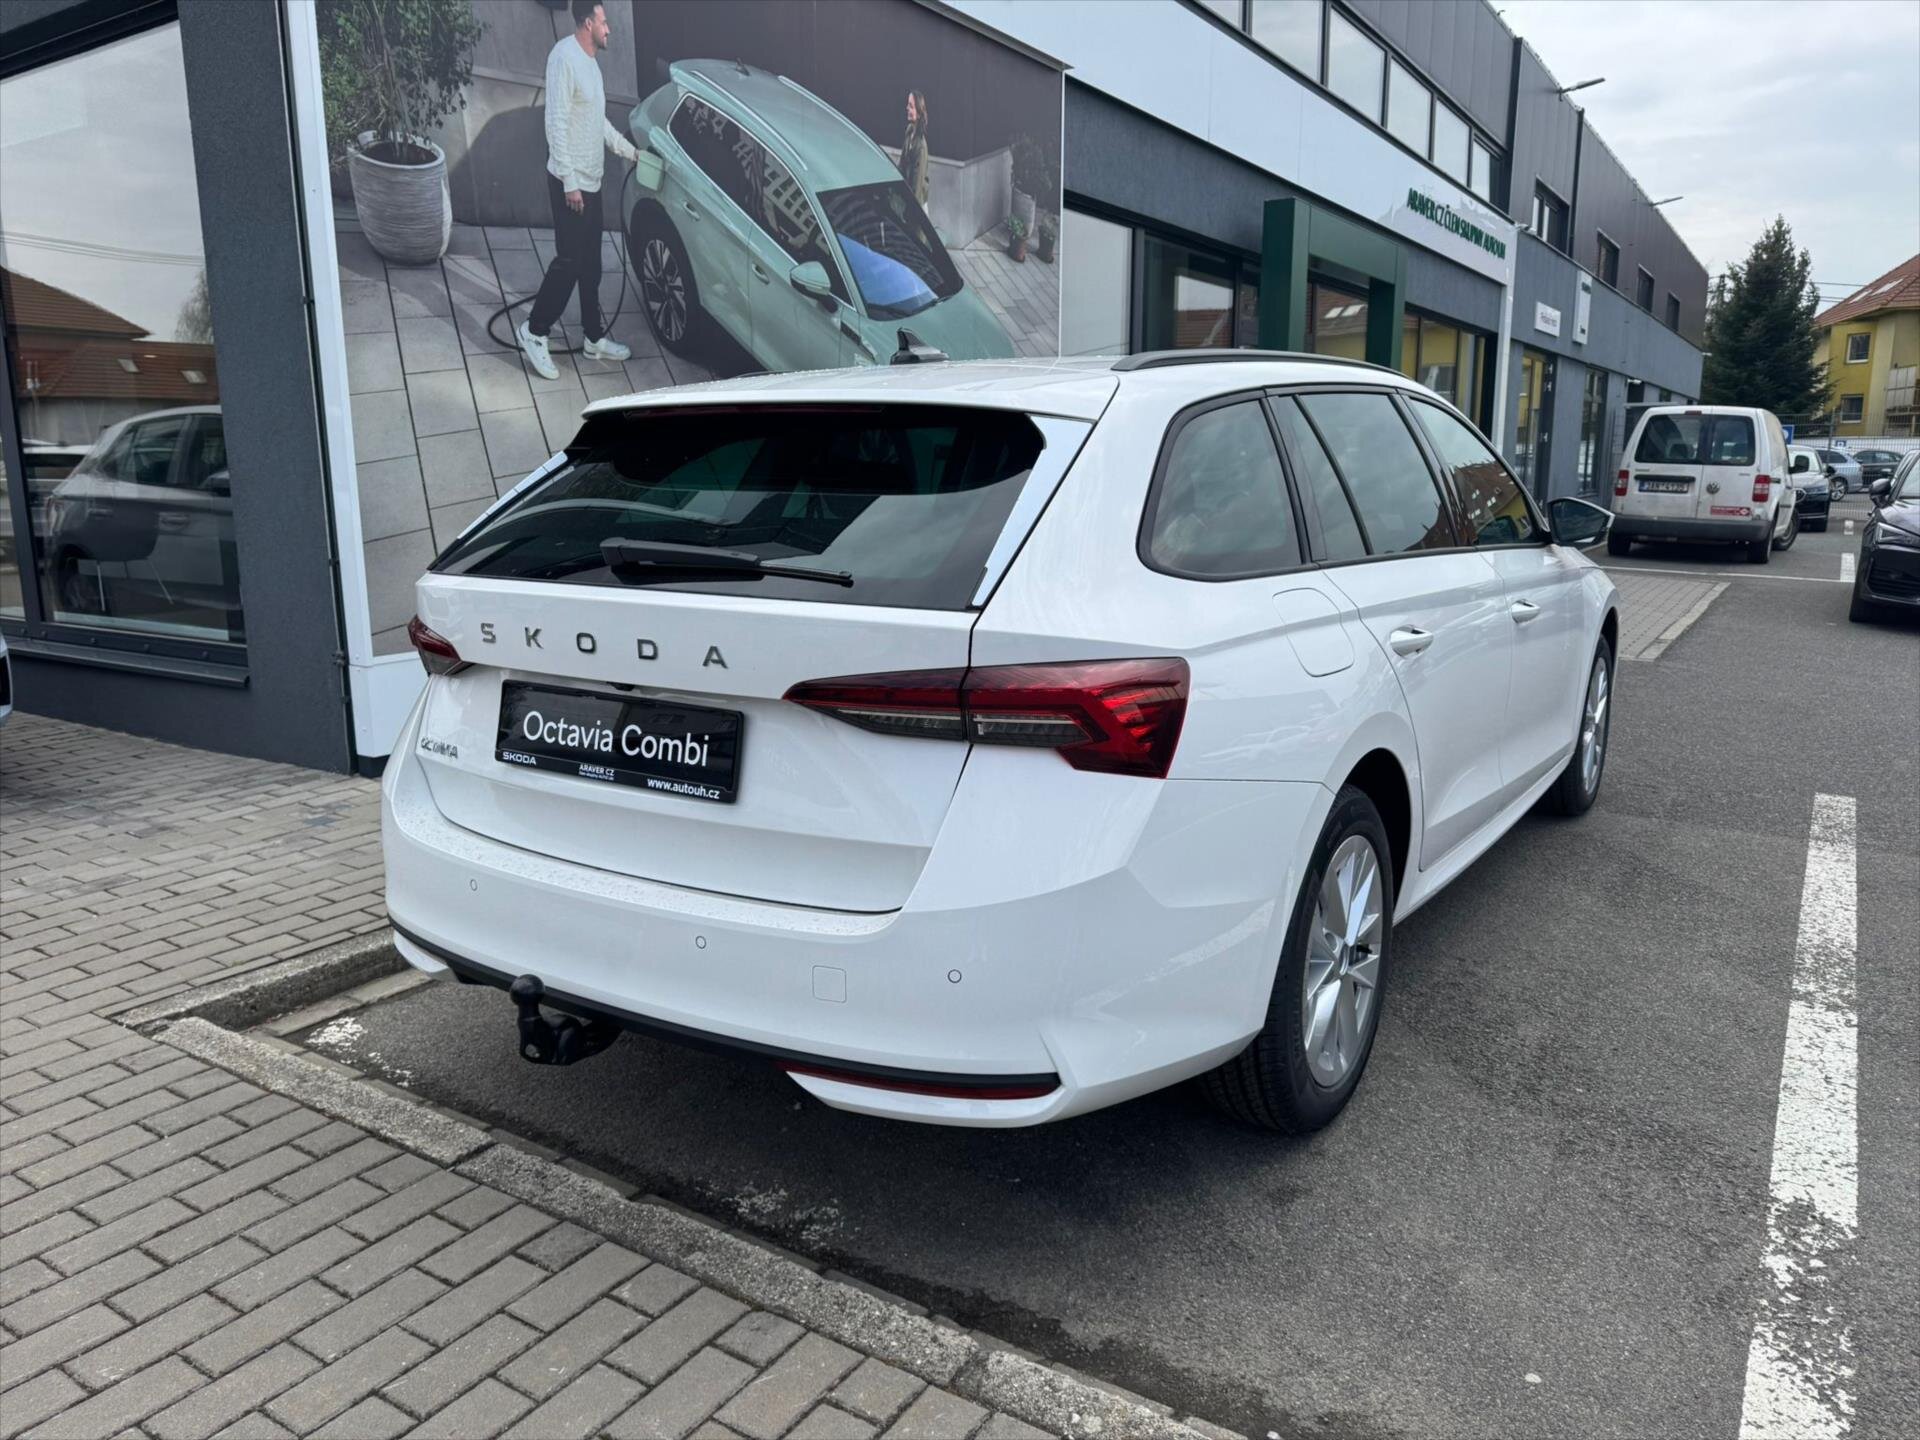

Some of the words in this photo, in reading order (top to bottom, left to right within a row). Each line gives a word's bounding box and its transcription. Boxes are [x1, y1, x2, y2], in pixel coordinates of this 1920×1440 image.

[480, 622, 729, 669] SKODA
[523, 711, 613, 752] Octavia
[621, 724, 709, 767] Combi
[502, 751, 537, 765] SKODA
[579, 763, 604, 774] ARAVER
[647, 778, 720, 800] www.autouh.cz
